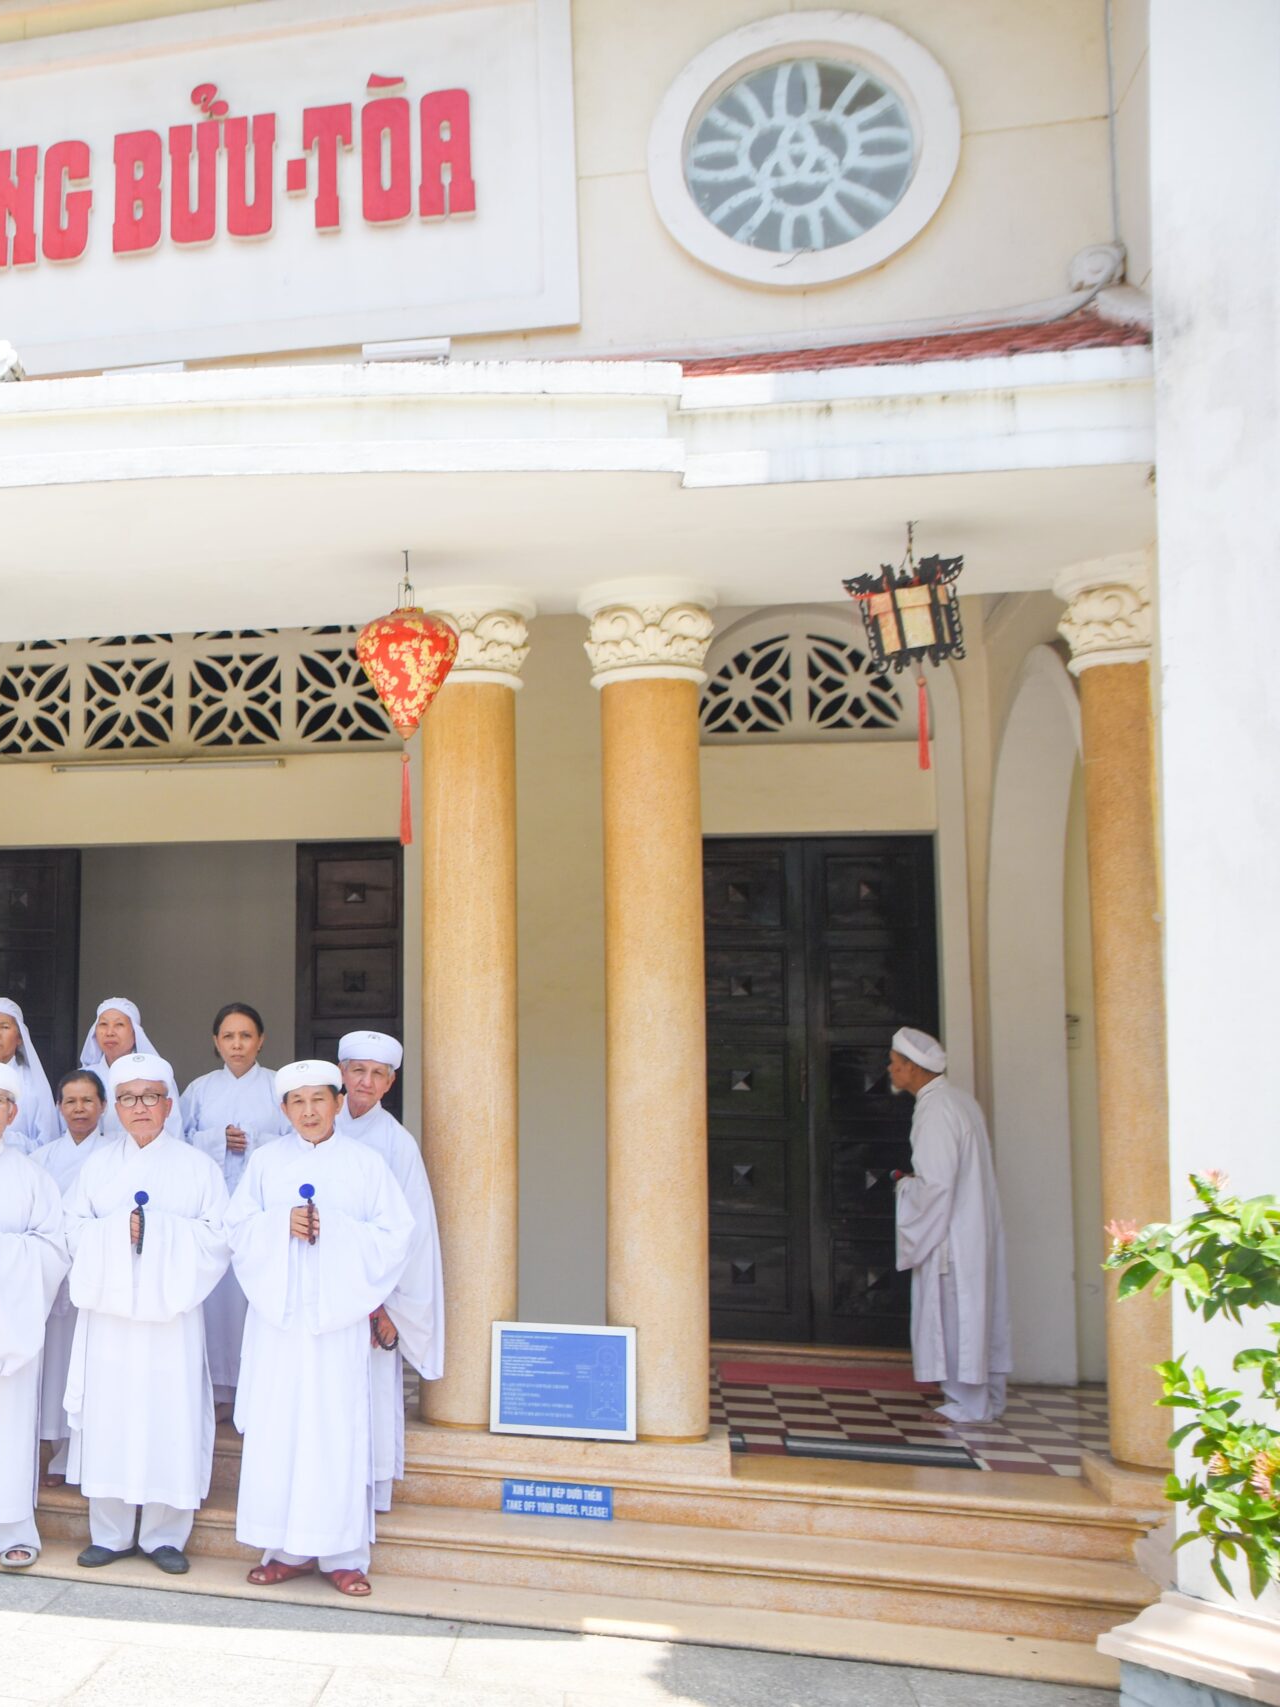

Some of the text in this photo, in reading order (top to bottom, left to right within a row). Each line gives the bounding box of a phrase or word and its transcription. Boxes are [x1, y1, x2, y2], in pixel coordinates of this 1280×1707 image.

[506, 1499, 523, 1511] TAKE
[523, 1500, 537, 1511] OFF
[537, 1502, 555, 1513] YOUR
